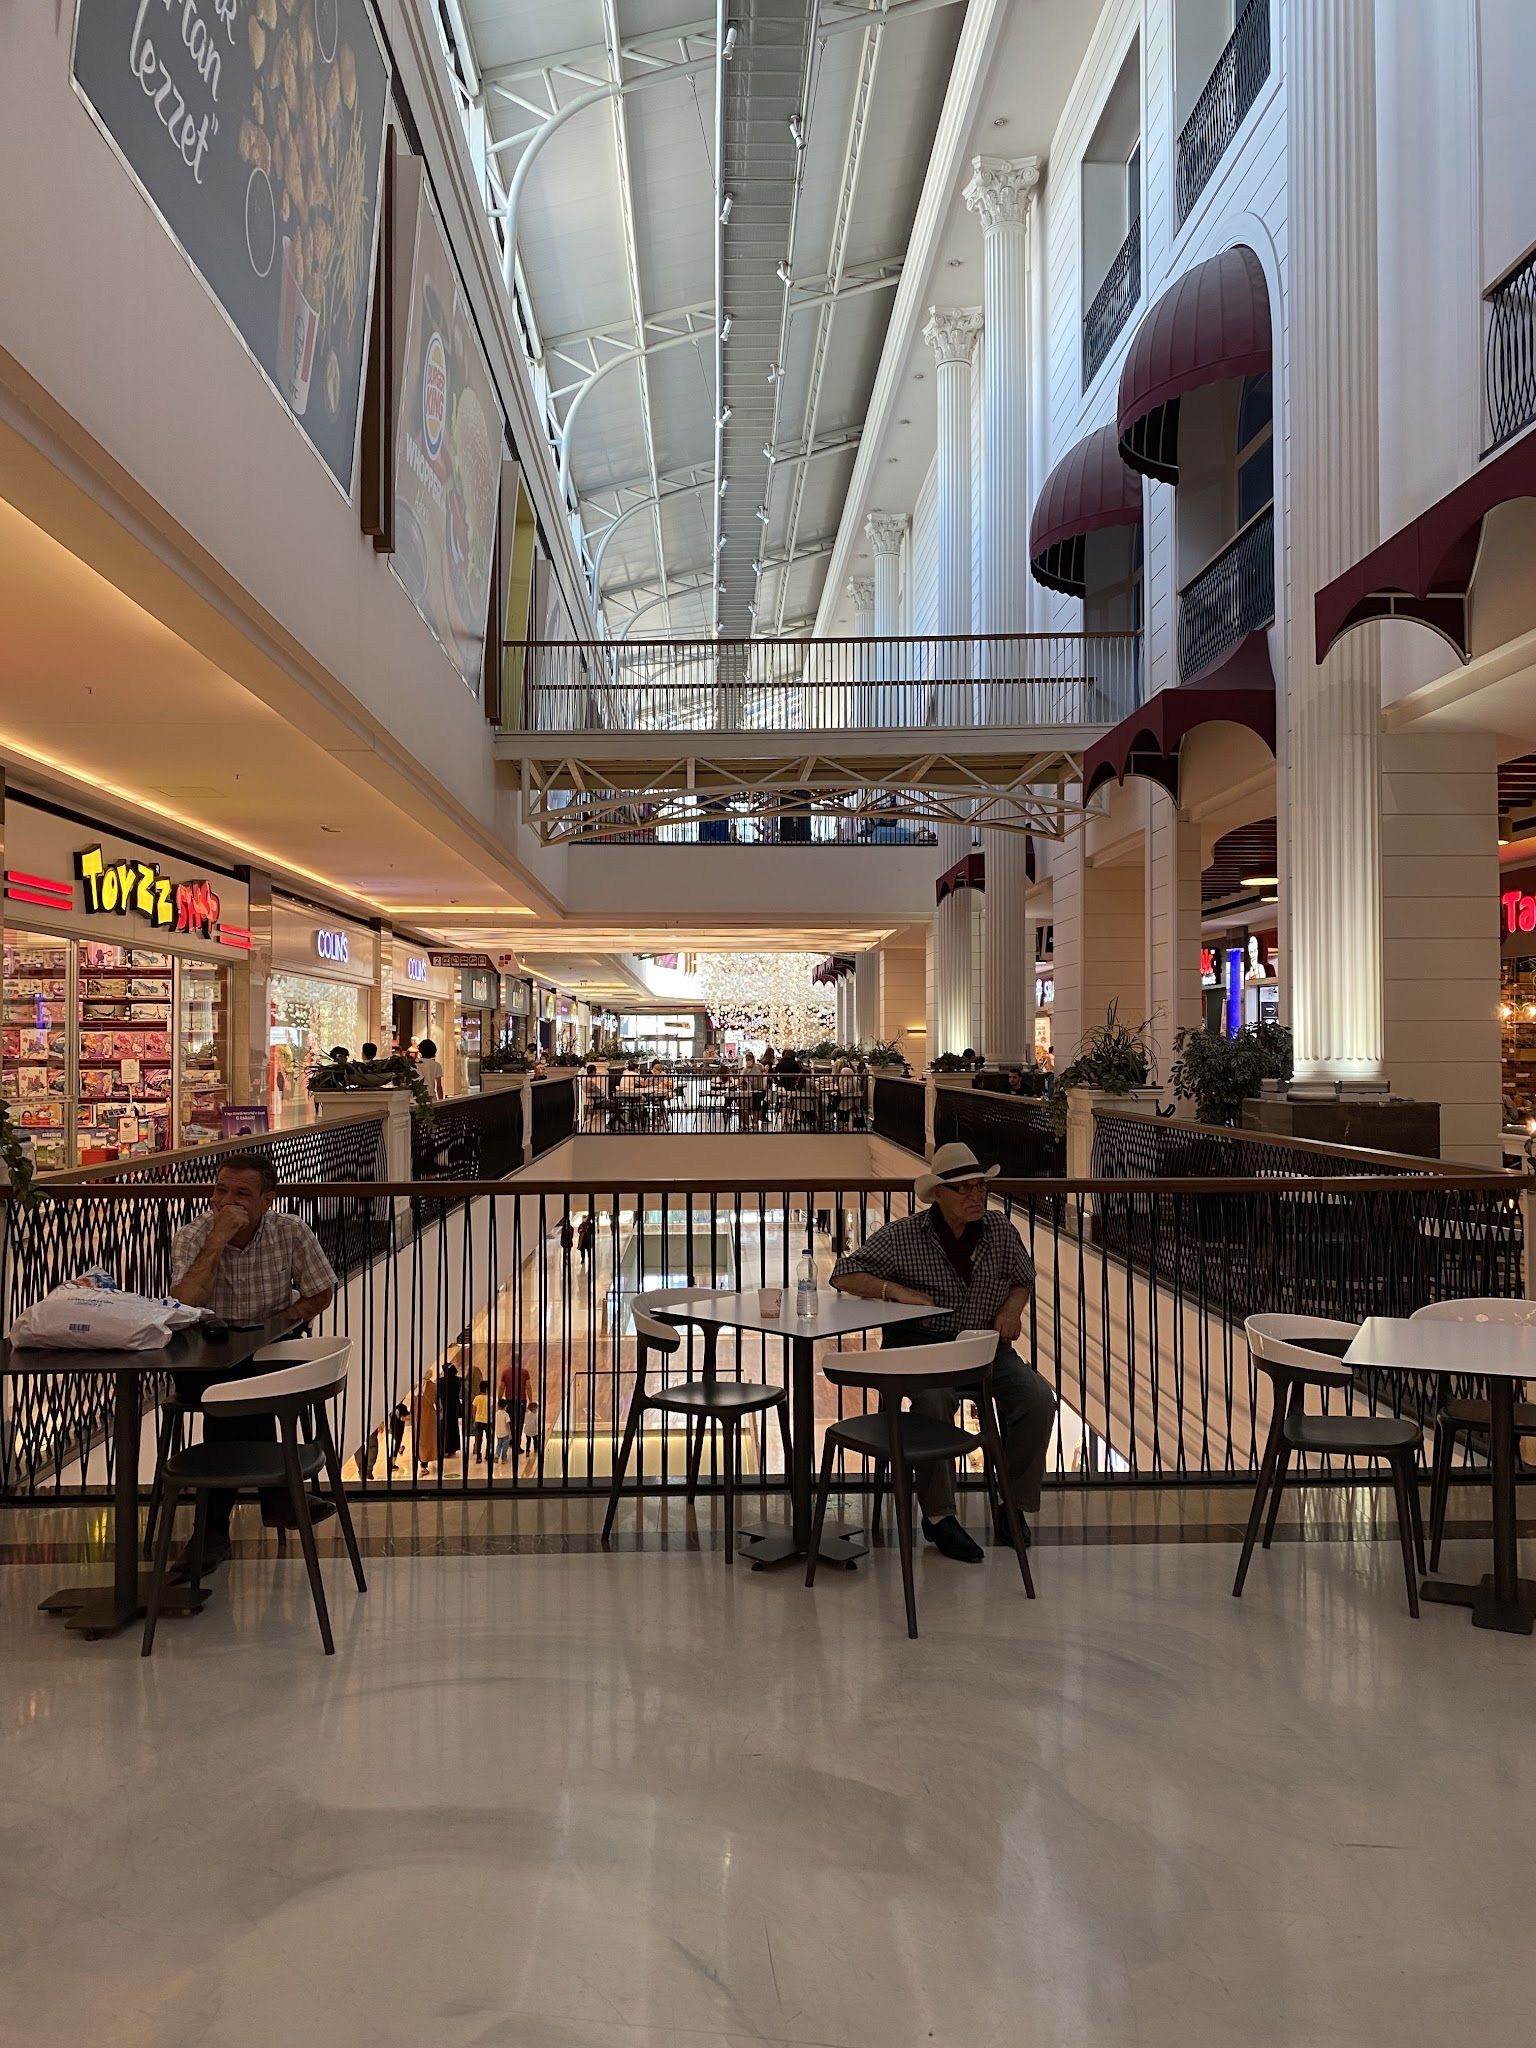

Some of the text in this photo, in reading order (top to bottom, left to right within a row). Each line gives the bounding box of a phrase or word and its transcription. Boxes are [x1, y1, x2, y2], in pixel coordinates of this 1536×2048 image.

[427, 365, 445, 394] BURGER
[425, 385, 444, 421] KING
[406, 432, 443, 507] WHOPPER
[1502, 890, 1536, 933] Ta
[317, 929, 349, 963] COLIN'S
[408, 957, 427, 982] COLIN'S
